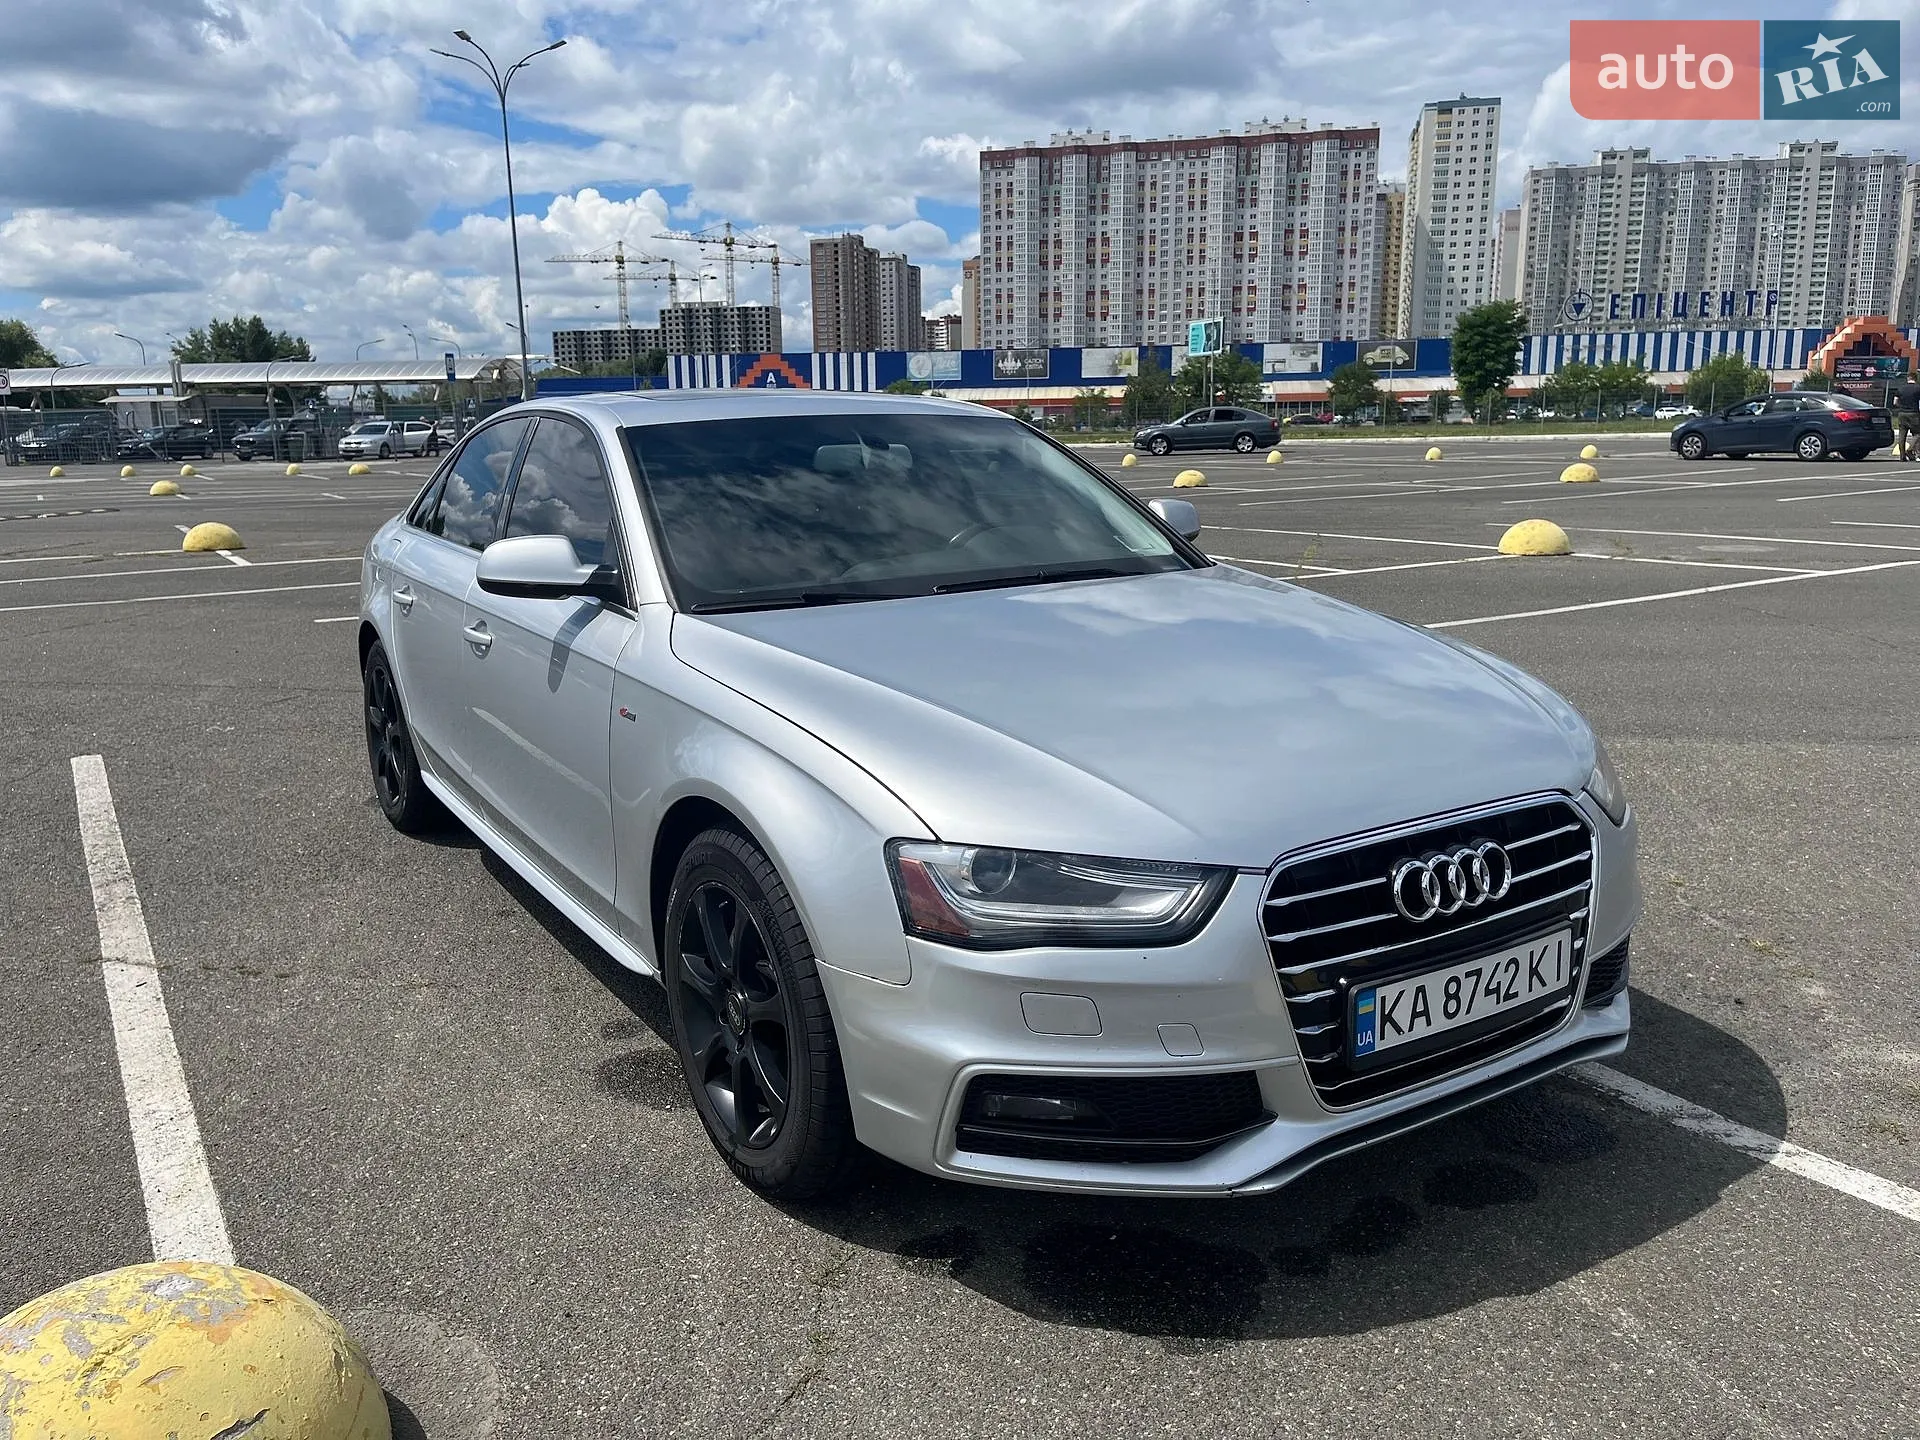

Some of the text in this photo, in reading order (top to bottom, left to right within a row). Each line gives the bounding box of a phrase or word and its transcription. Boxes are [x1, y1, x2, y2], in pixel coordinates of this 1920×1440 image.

[1609, 290, 1778, 320] ЕПІЦЕНТР
[1378, 984, 1432, 1041] KA
[1442, 957, 1520, 1020] 8742
[1357, 1030, 1374, 1046] UA
